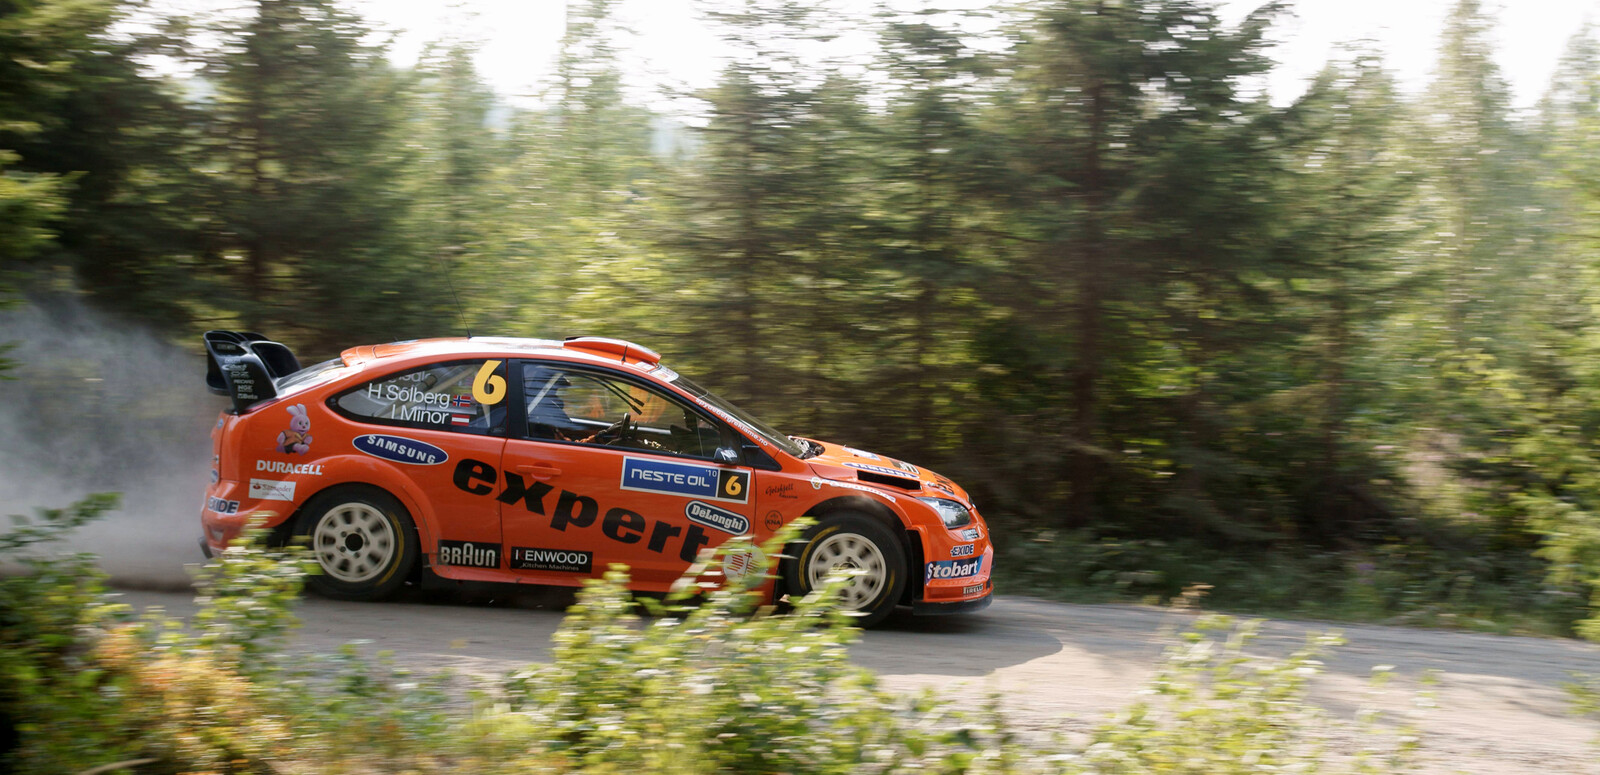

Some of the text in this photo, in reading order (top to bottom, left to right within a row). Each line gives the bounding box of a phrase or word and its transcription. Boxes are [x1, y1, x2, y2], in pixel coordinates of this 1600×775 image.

[472, 360, 507, 405] 6
[368, 383, 451, 408] H Solberg
[391, 404, 450, 424] I Minor
[367, 435, 437, 464] SAMSUNG
[256, 460, 323, 475] DURACELL
[631, 468, 710, 488] NESTE OIL
[725, 475, 742, 496] 6
[453, 458, 711, 563] expert
[440, 543, 497, 567] BRAUN
[952, 544, 974, 556] EXIDE
[927, 560, 978, 579] Stobart
